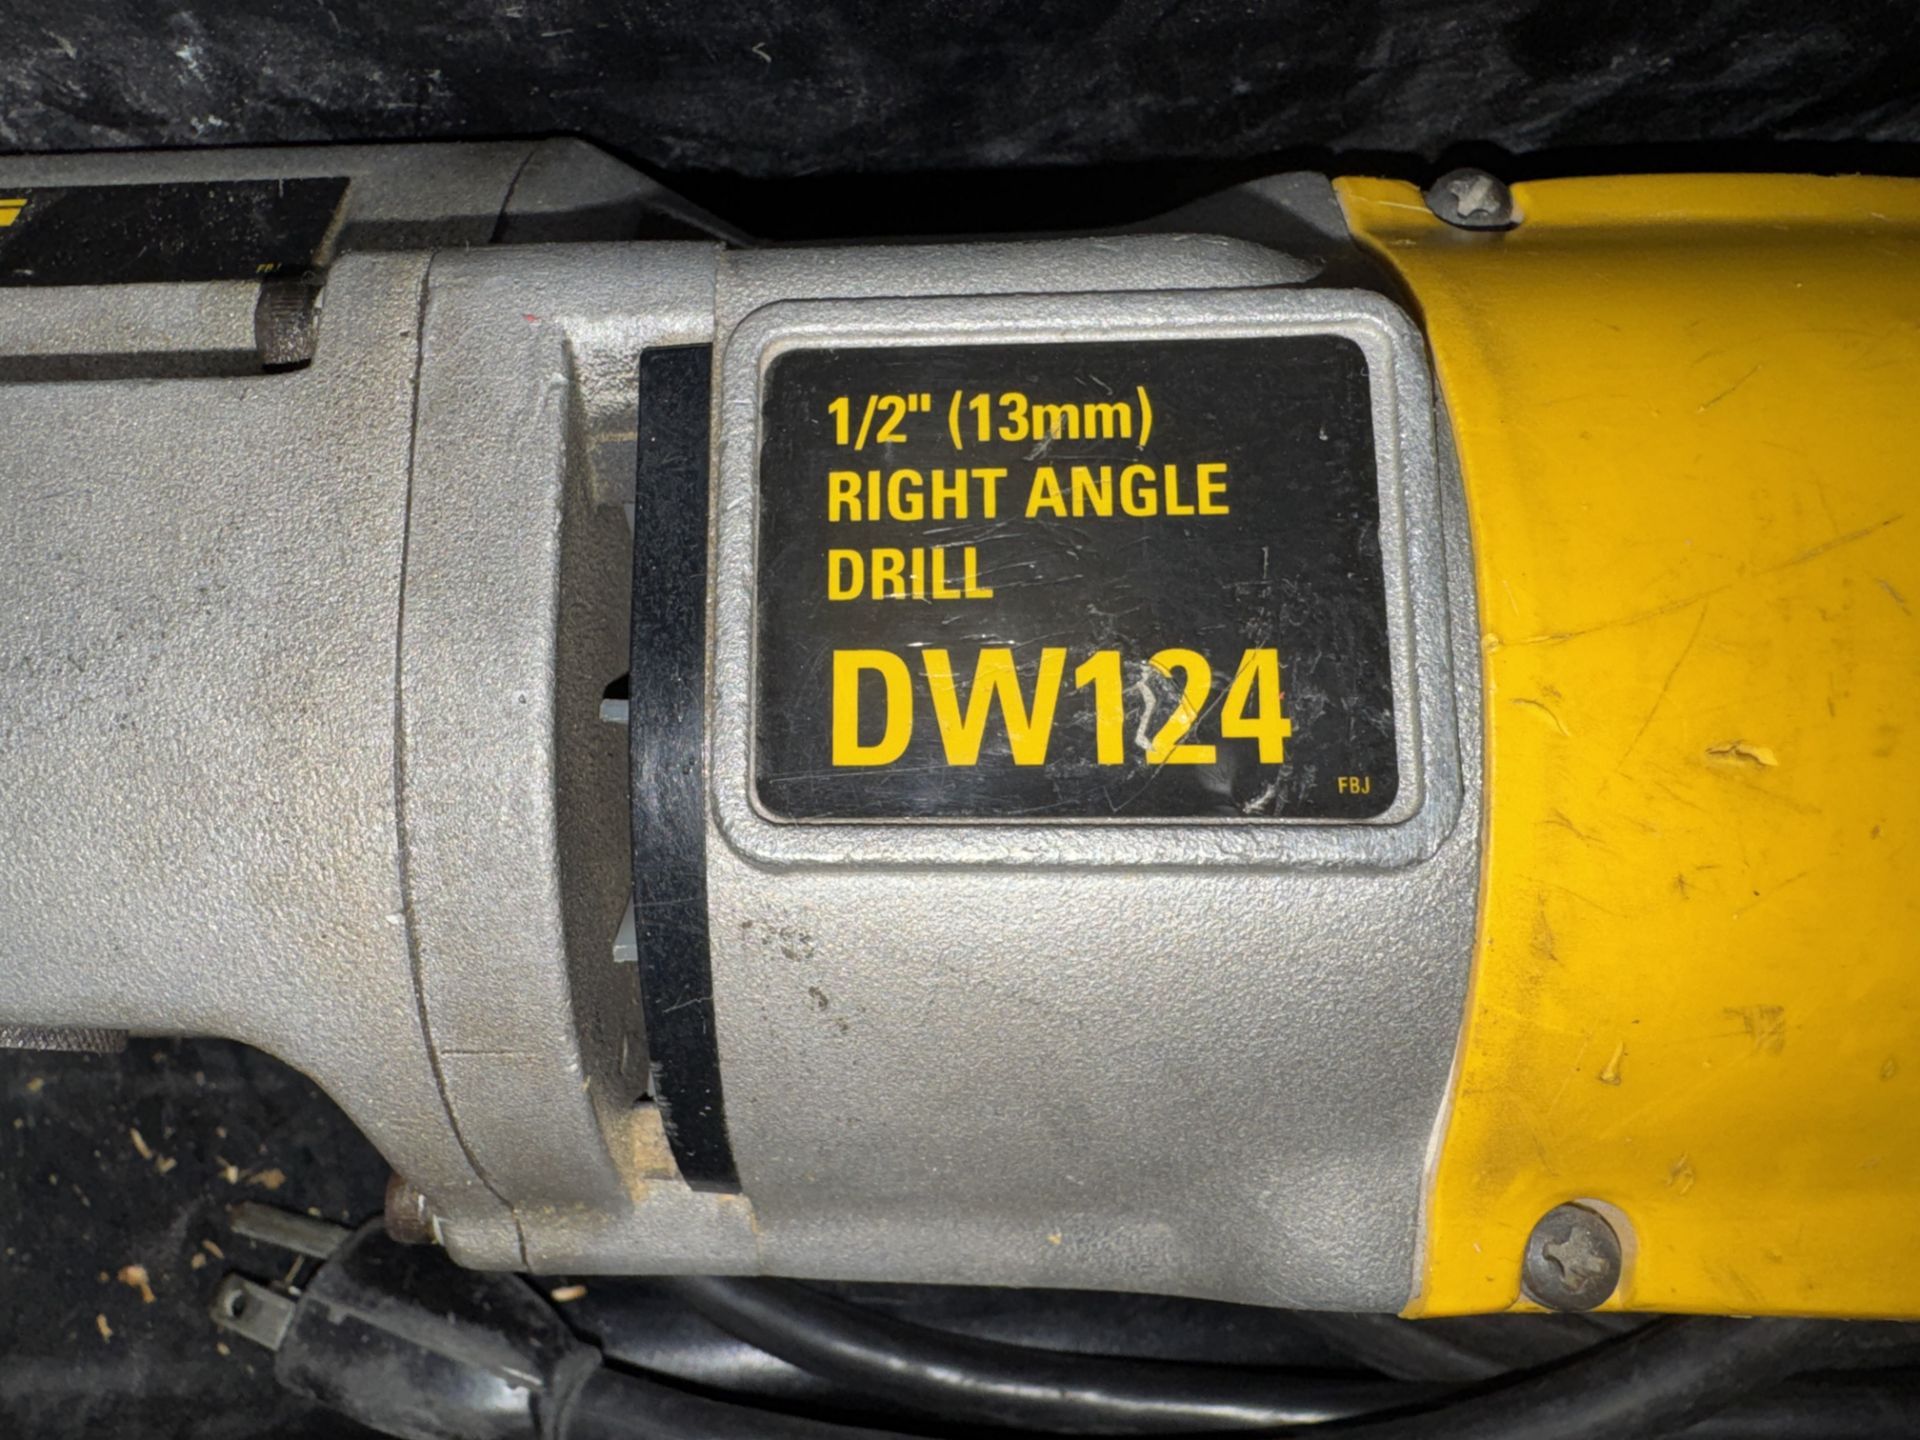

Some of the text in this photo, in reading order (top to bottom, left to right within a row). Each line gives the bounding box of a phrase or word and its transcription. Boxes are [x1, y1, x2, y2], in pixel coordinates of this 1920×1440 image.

[827, 385, 1154, 452] 1/2" (13mm)
[827, 462, 1230, 523] RIGHT ANGLE
[827, 546, 994, 602] DRILL
[831, 646, 1293, 768] DW124
[1337, 775, 1371, 795] FBJ
